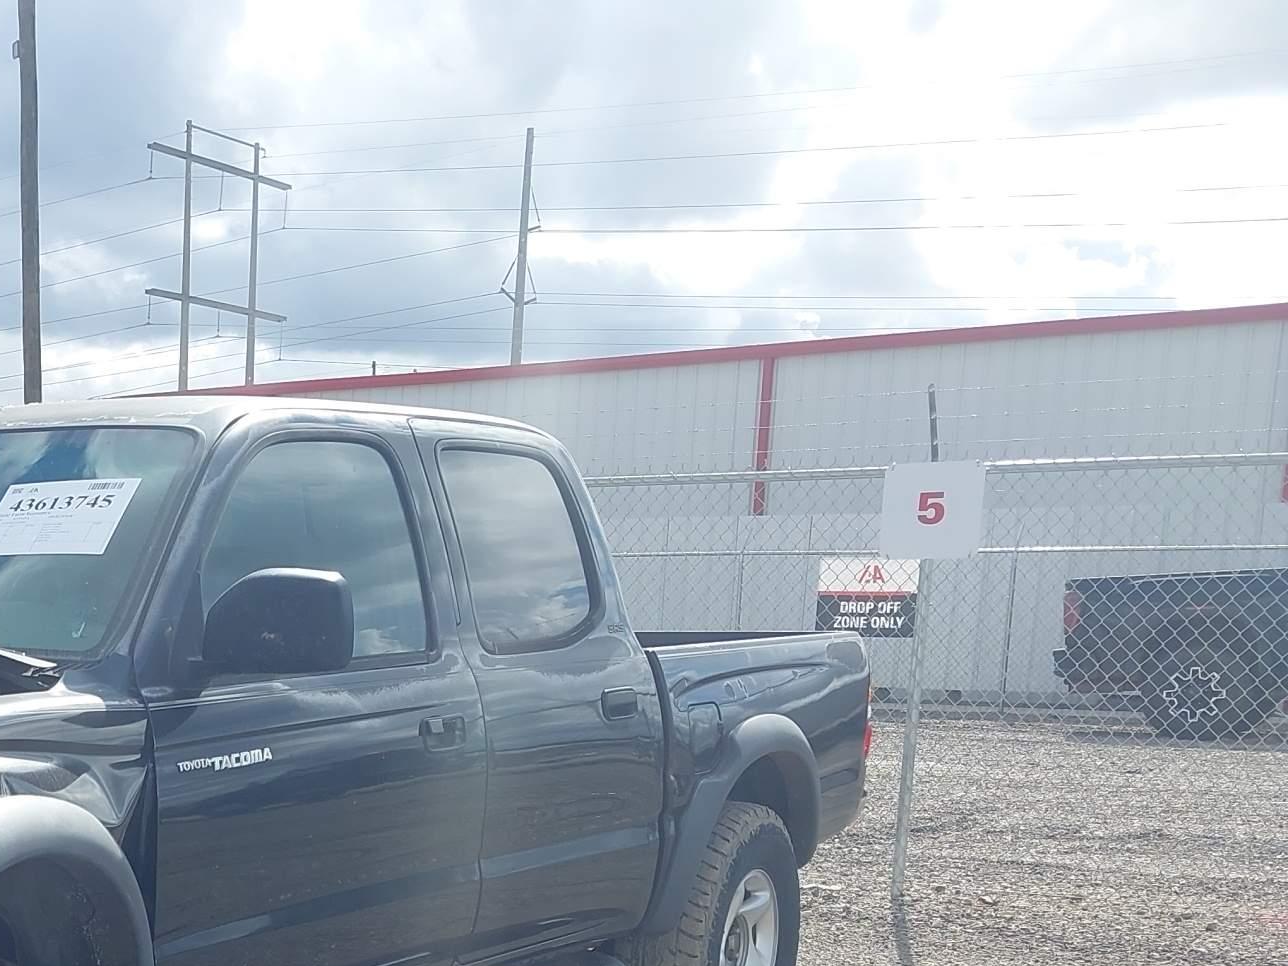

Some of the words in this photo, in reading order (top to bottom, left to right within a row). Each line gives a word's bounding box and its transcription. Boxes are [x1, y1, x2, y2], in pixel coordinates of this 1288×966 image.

[9, 494, 116, 512] 43613745
[917, 491, 945, 525] 5
[839, 601, 875, 614] DROP
[877, 601, 902, 614] OFF
[833, 616, 868, 629] ZONE
[870, 616, 905, 629] ONLY
[177, 758, 212, 772] TOYOTA
[211, 747, 273, 772] TACOMA
